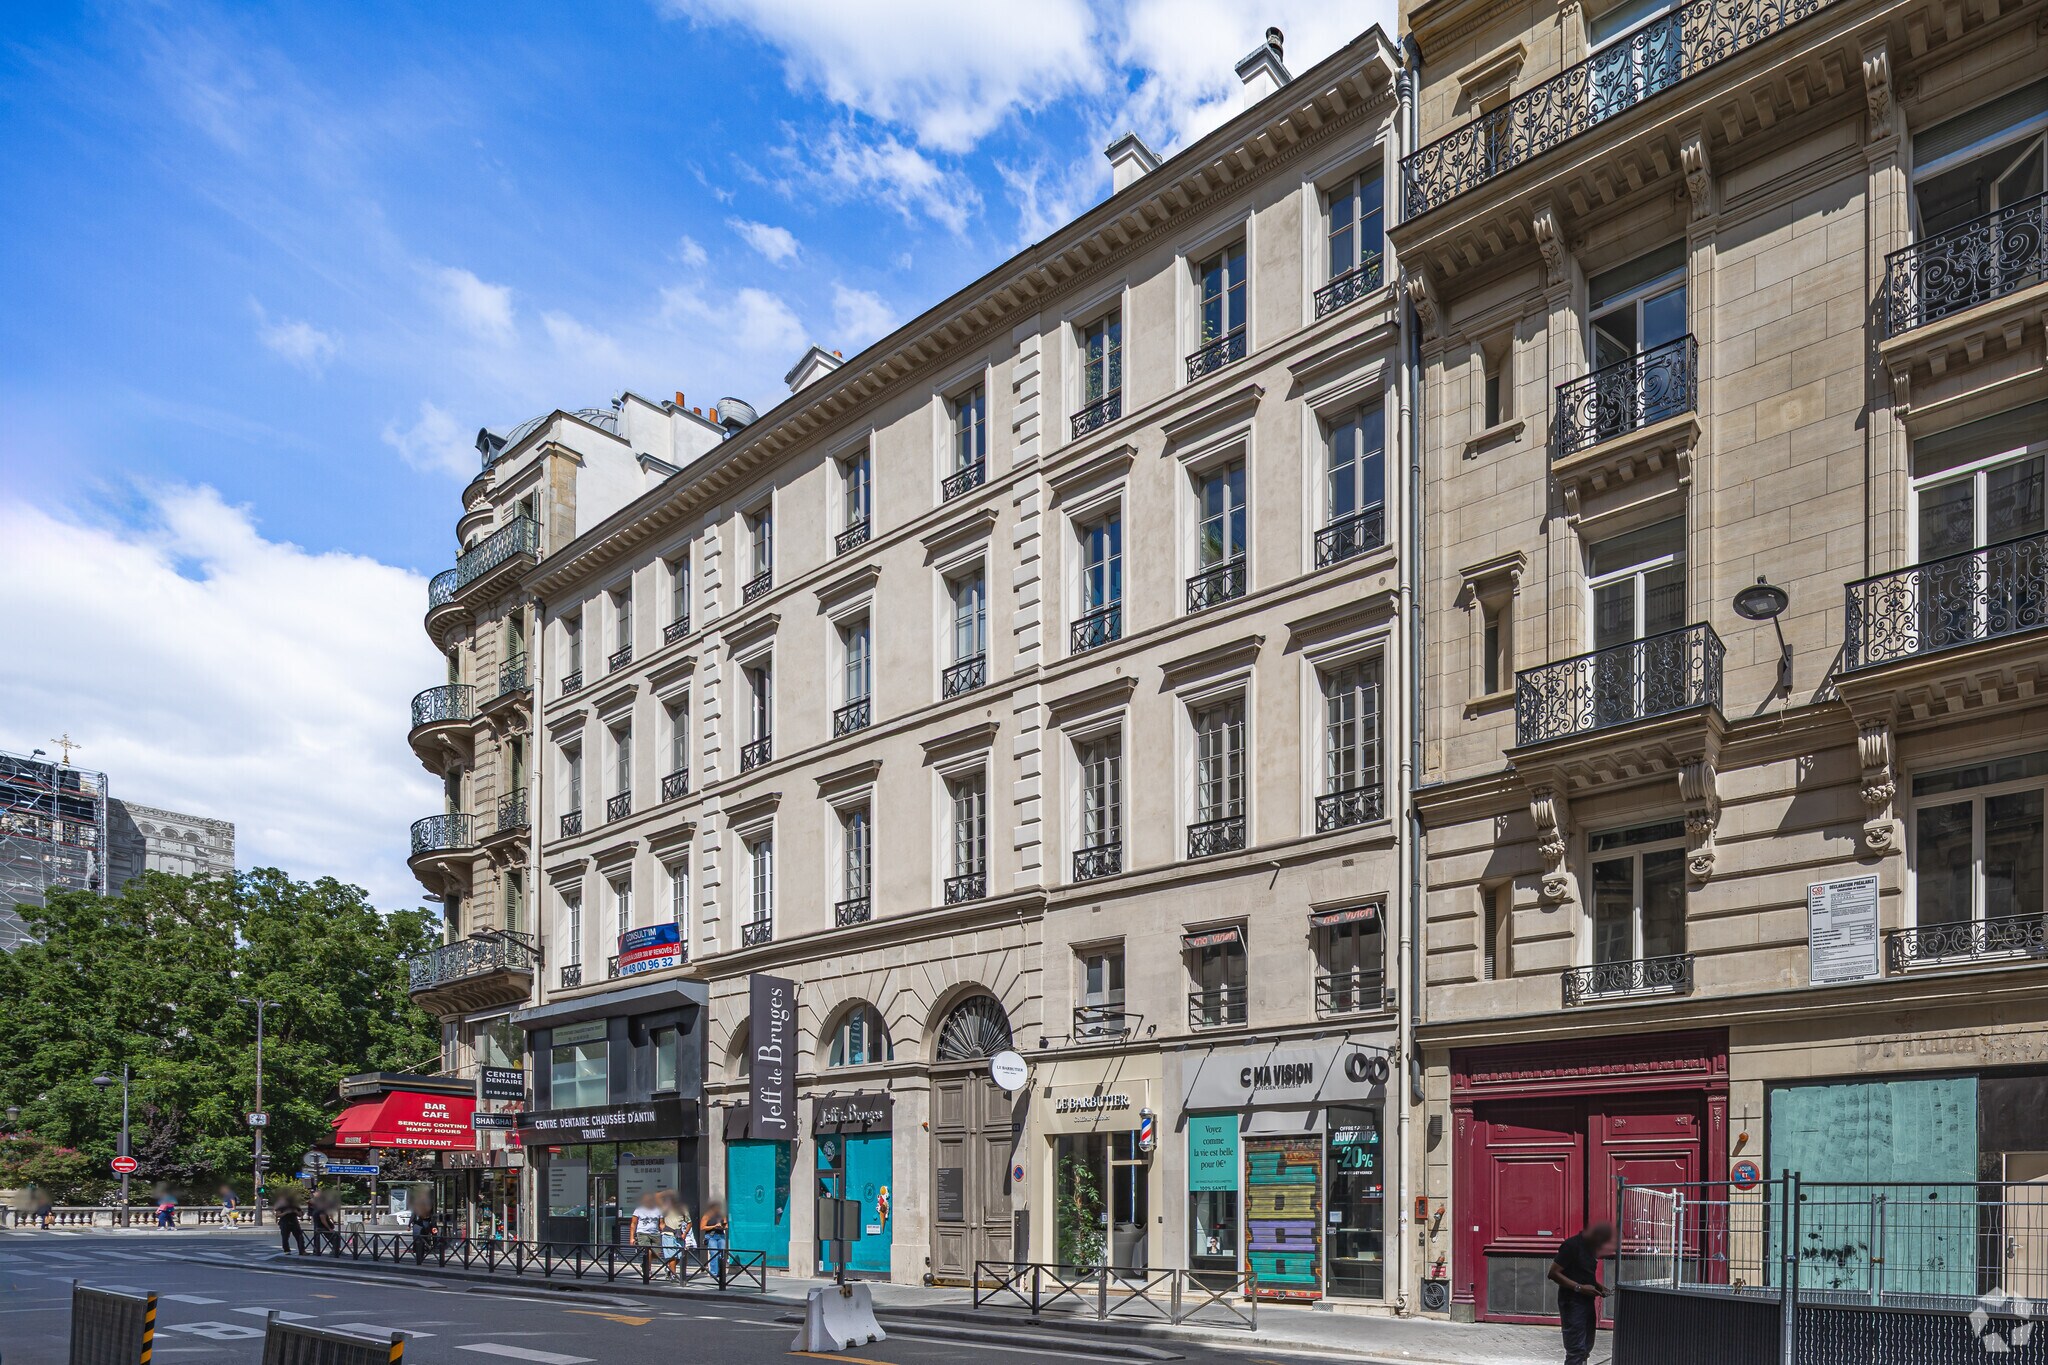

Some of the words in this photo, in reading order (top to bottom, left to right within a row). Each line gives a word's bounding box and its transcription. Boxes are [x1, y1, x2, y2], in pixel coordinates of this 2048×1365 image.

[629, 963, 637, 974] 48
[637, 961, 647, 971] 00
[648, 959, 660, 970] 96
[661, 956, 674, 967] 32
[758, 987, 790, 1066] Bruges
[486, 1070, 523, 1080] CENTRE
[768, 1068, 783, 1085] de
[1254, 1066, 1271, 1087] MA
[1274, 1063, 1313, 1086] VISION
[486, 1077, 523, 1086] DENTAIRE
[424, 1102, 446, 1111] BAR
[1056, 1097, 1069, 1110] LE
[1069, 1094, 1129, 1109] BARBUTIER
[760, 1087, 787, 1129] Jeff
[422, 1111, 450, 1119] CAFE
[849, 1103, 884, 1125] Bruges
[398, 1120, 432, 1128] SERVICE
[475, 1117, 512, 1126] SHANGHAI
[535, 1118, 558, 1131] CENTRE
[560, 1116, 590, 1128] DENTAIRE
[591, 1110, 626, 1126] CHAUSSÉE
[628, 1111, 655, 1124] D'ANTIN
[581, 1125, 606, 1139] TRINITÉ
[1205, 1126, 1222, 1135] Voyez
[1334, 1131, 1377, 1142] OUVERTURE
[396, 1138, 452, 1147] RESTAURANT
[1194, 1149, 1199, 1157] la
[1200, 1148, 1209, 1157] vie
[1209, 1149, 1218, 1157] est
[1220, 1147, 1234, 1156] belle
[1201, 1162, 1215, 1170] pour
